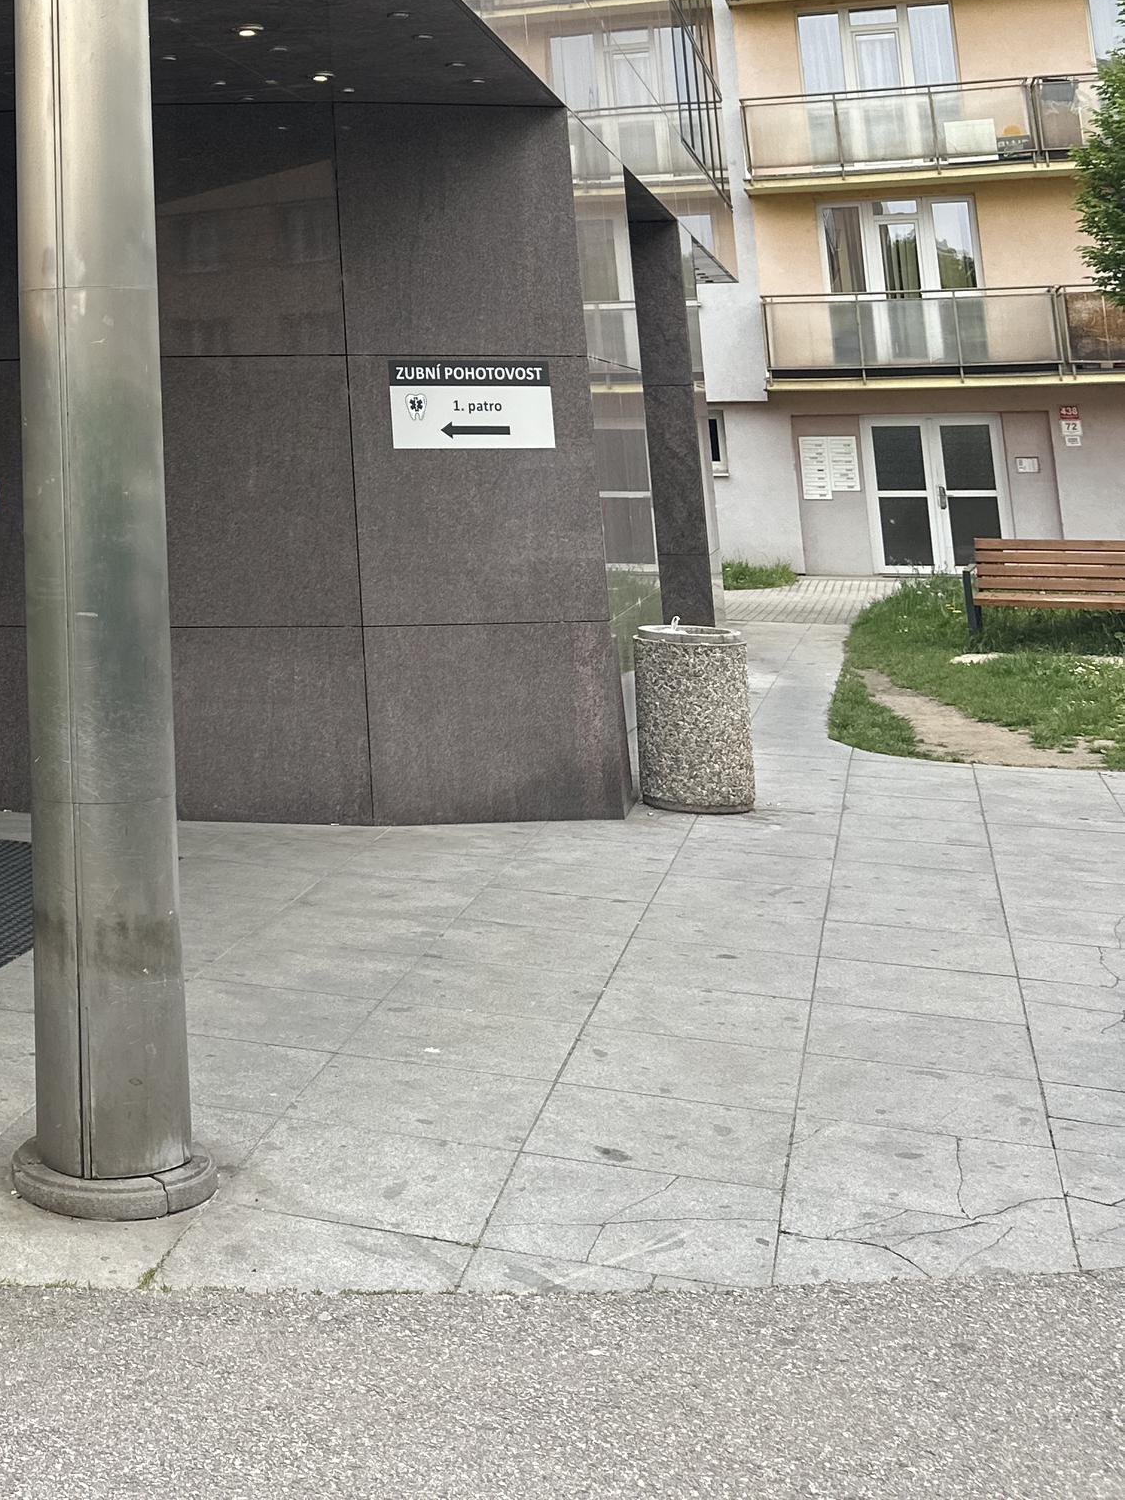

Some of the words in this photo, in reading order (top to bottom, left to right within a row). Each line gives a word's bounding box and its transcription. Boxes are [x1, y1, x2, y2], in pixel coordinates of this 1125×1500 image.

[396, 363, 441, 380] ZUBNÍ
[445, 366, 543, 381] POHOTOVOST
[453, 400, 464, 412] 1.
[469, 400, 502, 414] patro
[1065, 422, 1077, 430] 72
